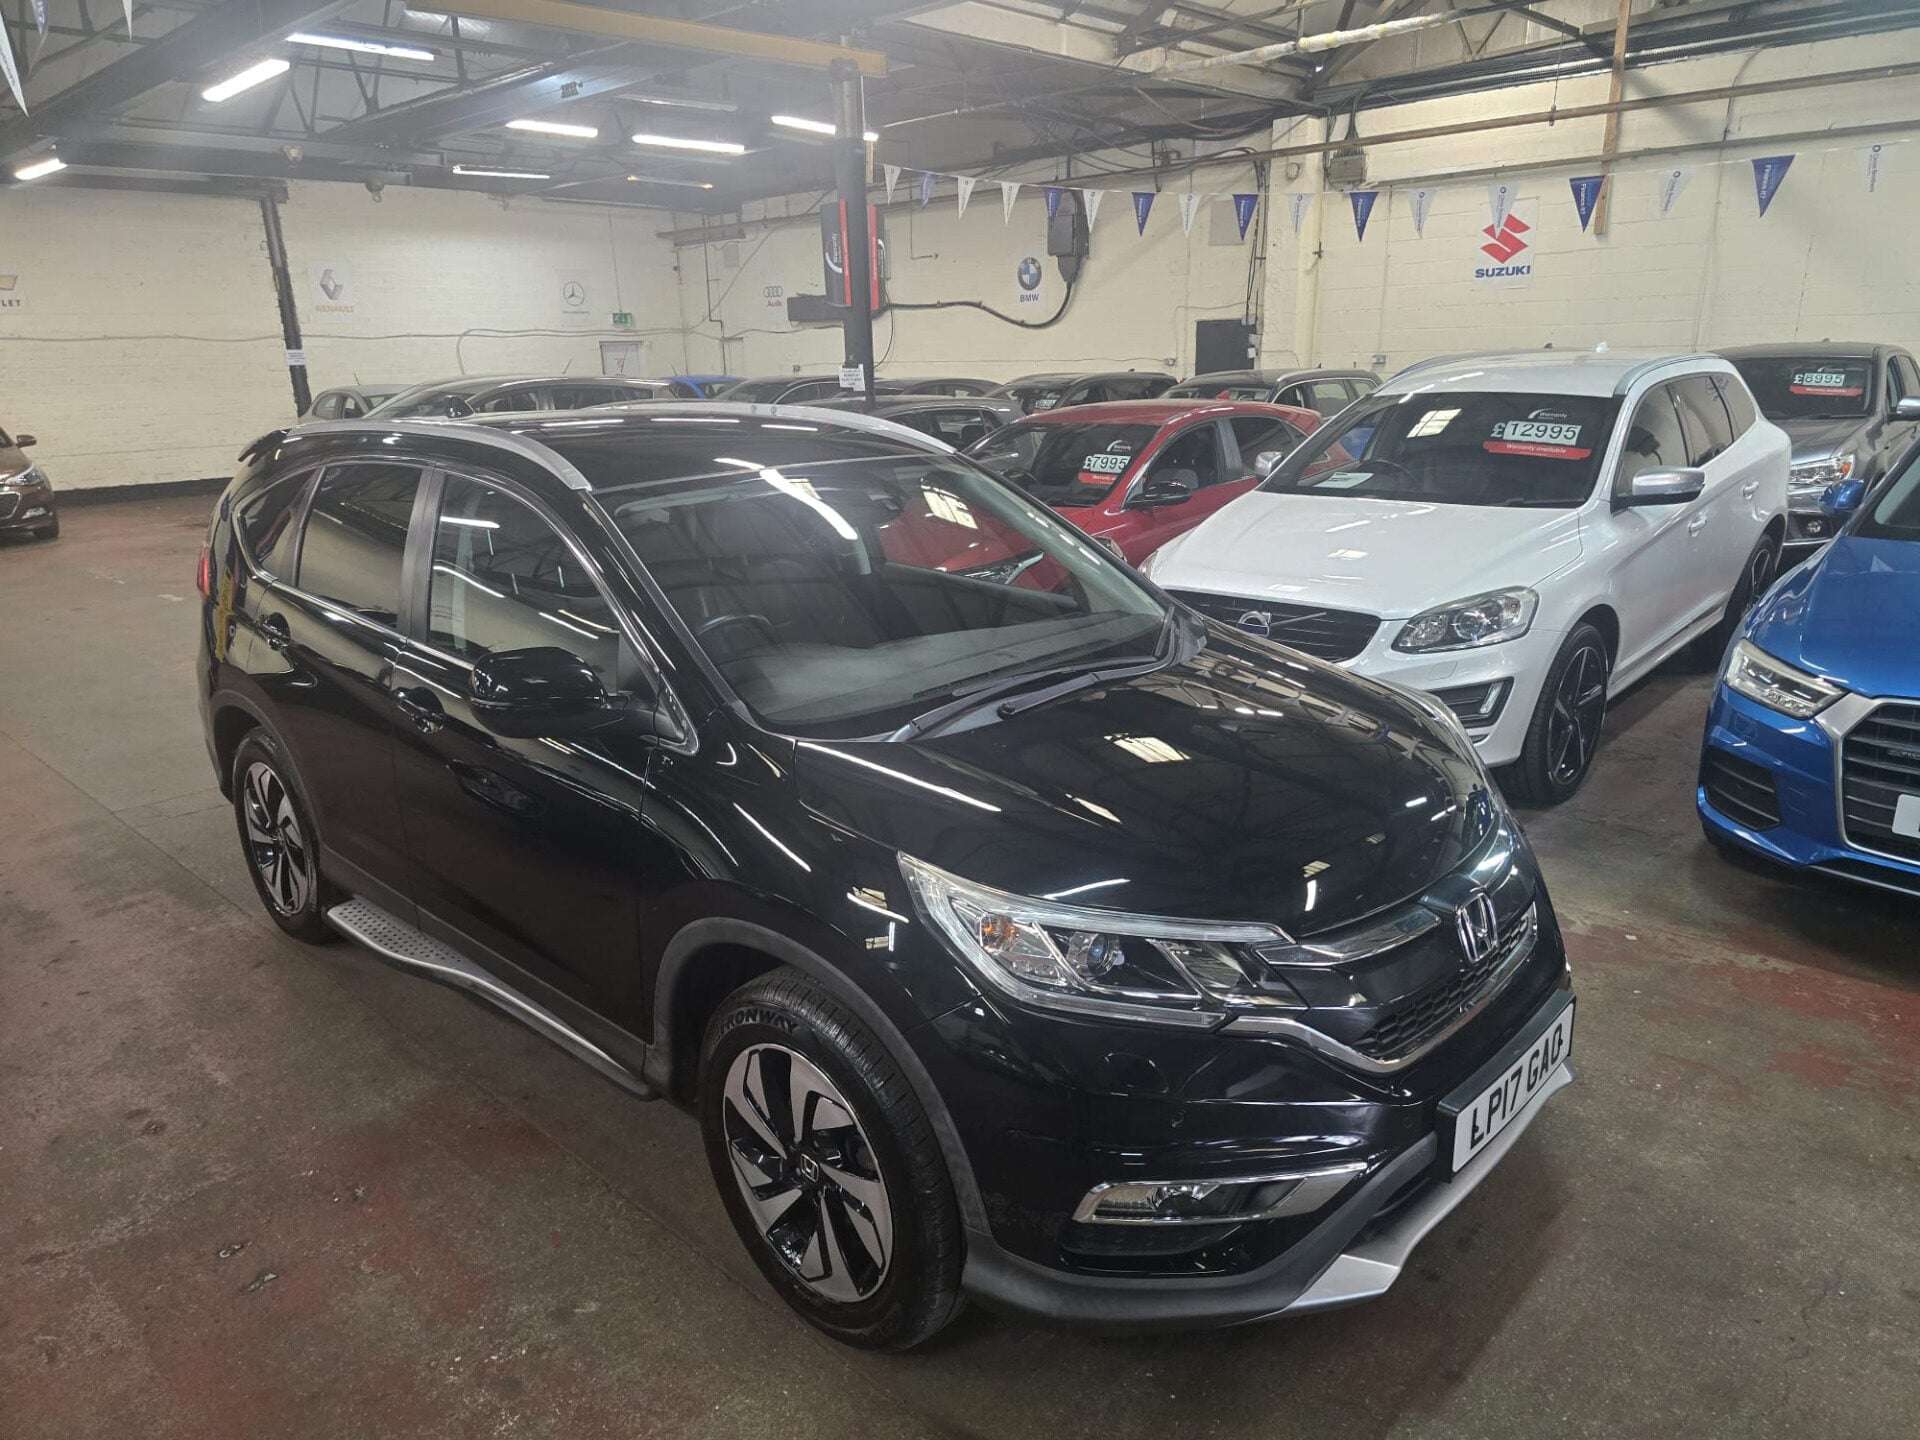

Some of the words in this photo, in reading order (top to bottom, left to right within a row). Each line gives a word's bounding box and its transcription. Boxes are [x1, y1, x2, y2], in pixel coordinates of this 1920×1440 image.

[1475, 265, 1531, 278] SUZUKI
[1019, 293, 1040, 303] BMW
[1490, 422, 1577, 440] £12995
[1083, 455, 1127, 470] £7995
[1470, 1064, 1523, 1149] LP17
